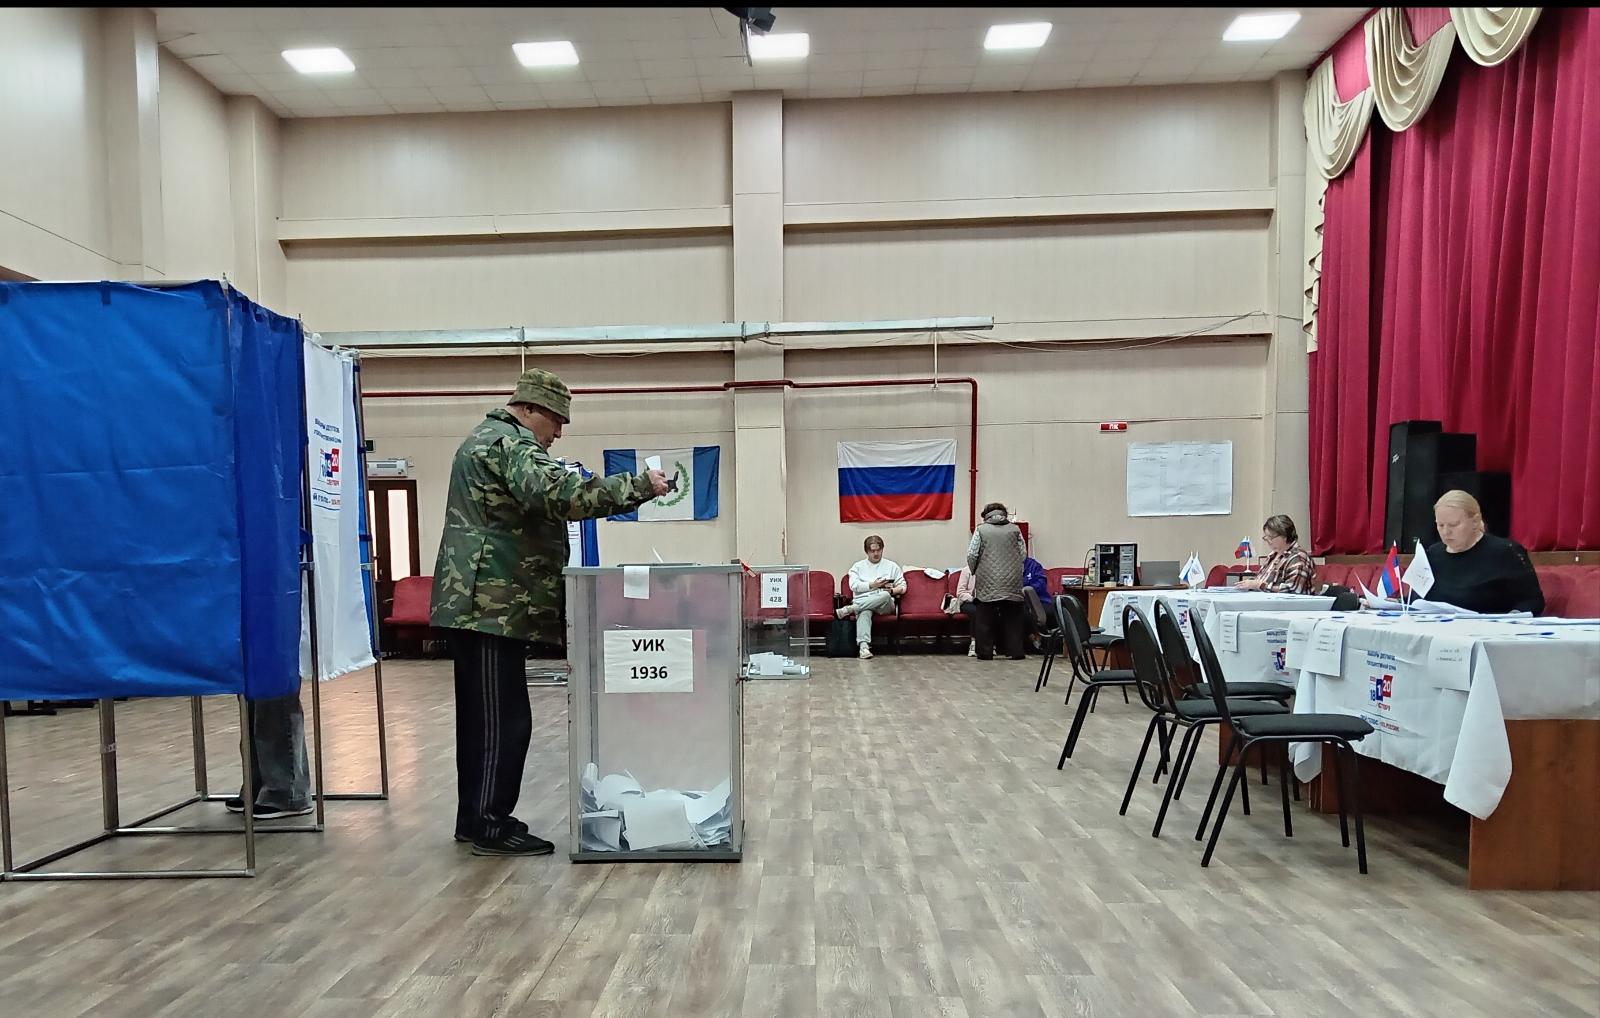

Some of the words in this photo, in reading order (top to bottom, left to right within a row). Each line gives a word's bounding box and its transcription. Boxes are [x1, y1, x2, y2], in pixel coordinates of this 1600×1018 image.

[631, 638, 666, 652] УИК
[630, 665, 668, 680] 1936
[1382, 679, 1391, 693] 20
